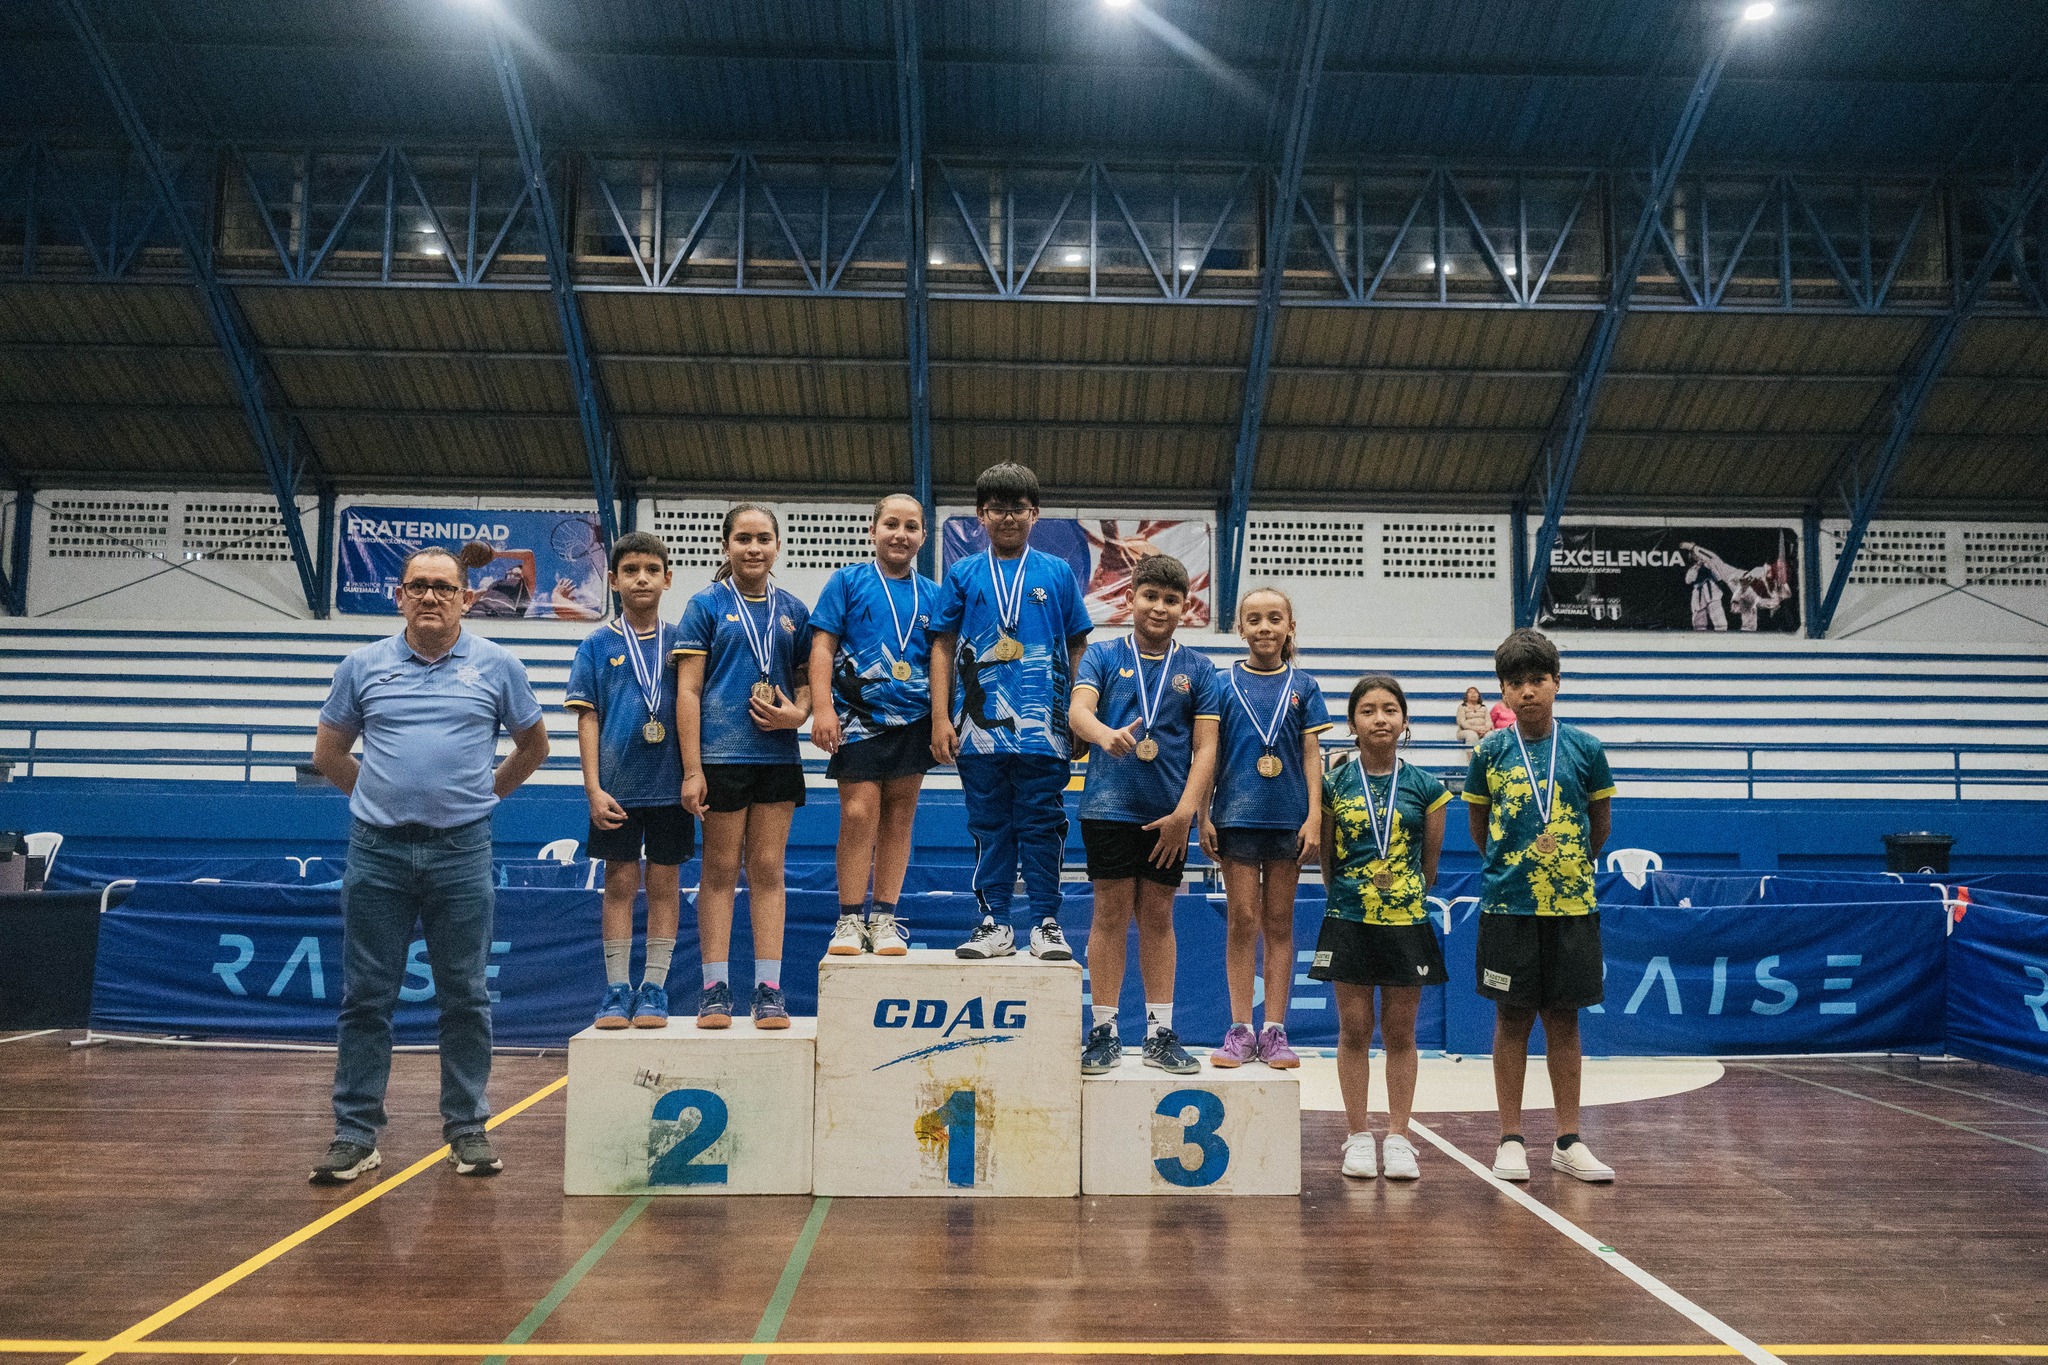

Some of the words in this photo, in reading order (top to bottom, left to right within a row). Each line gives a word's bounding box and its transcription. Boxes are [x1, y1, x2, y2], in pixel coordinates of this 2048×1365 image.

[347, 518, 510, 540] FRATERNIDAD
[1550, 550, 1686, 566] EXCELENCIA
[1585, 954, 1863, 1015] AISE
[873, 996, 1027, 1038] CDAG
[648, 1088, 729, 1188] 2
[921, 1090, 976, 1188] 1
[1153, 1089, 1230, 1188] 3
